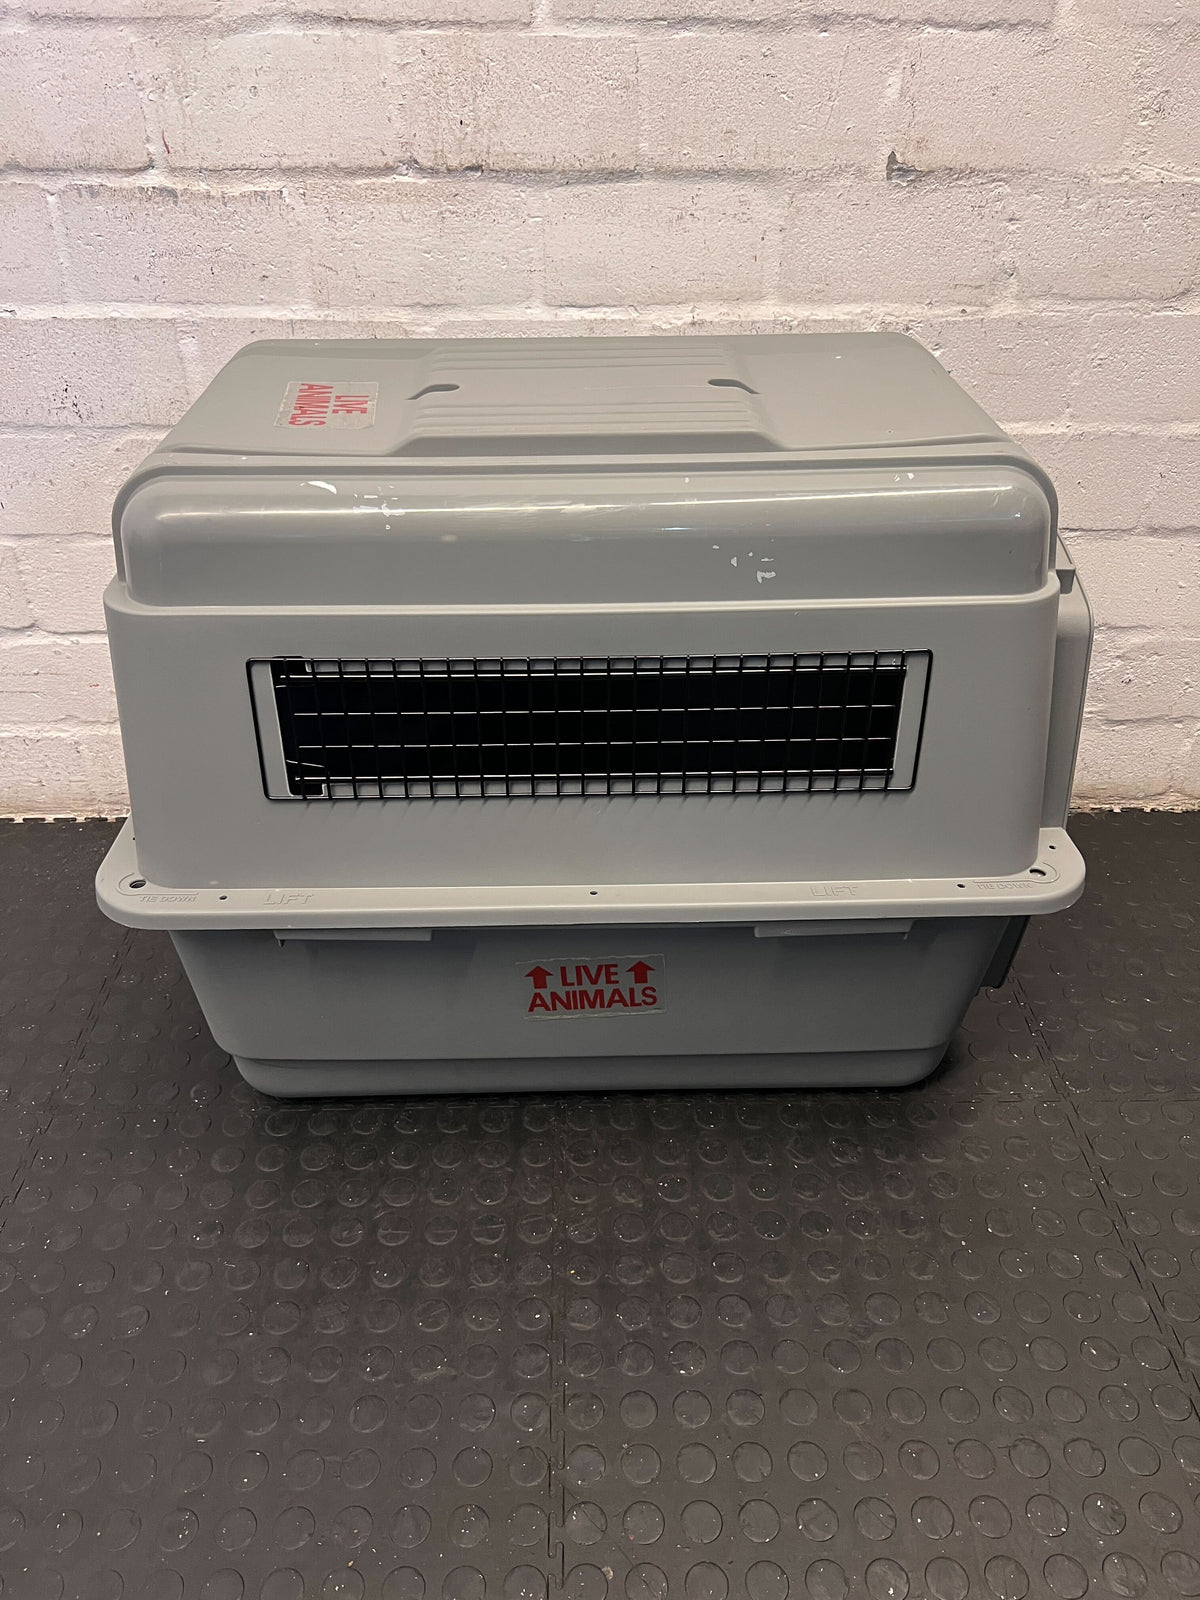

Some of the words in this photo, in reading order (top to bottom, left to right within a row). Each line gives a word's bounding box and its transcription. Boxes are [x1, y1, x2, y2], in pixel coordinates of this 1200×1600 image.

[288, 383, 334, 426] ANIMALS
[331, 395, 369, 414] LIVE
[263, 893, 314, 906] LIFT
[810, 885, 858, 897] LIFT
[560, 964, 620, 987] LIVE
[528, 986, 658, 1013] ANIMALS
